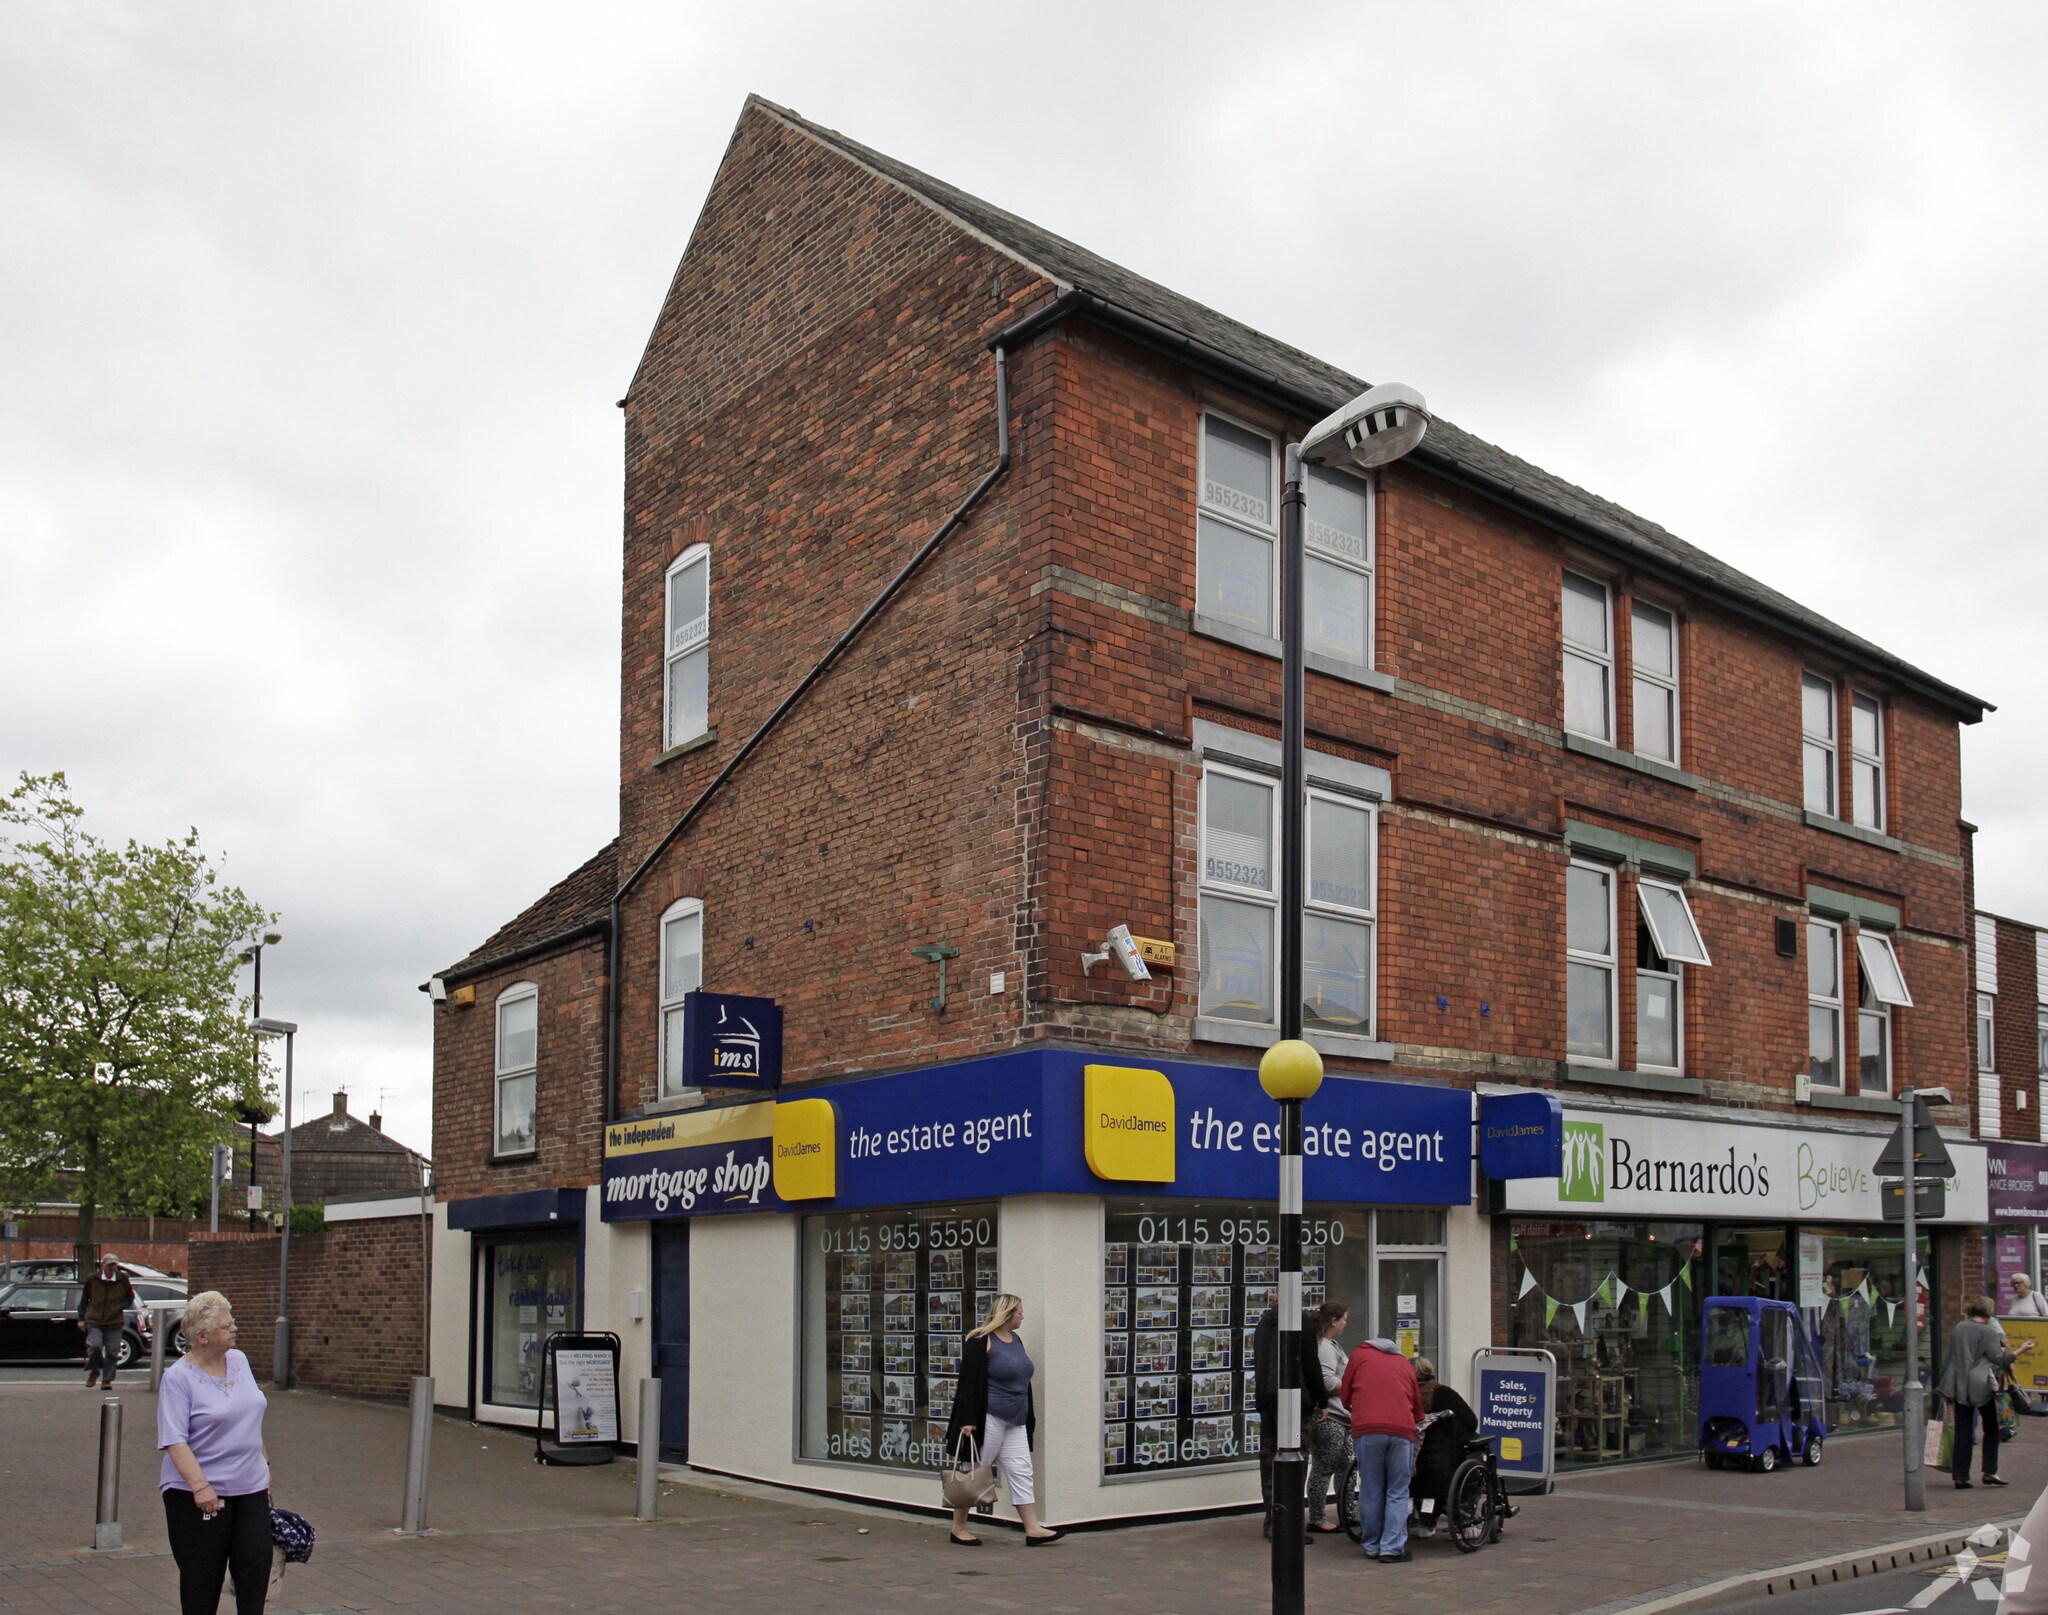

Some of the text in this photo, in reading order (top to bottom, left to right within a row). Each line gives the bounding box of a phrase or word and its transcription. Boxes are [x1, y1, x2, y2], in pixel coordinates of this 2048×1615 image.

[1206, 483, 1265, 520] 9552323
[1308, 523, 1360, 556] 9552323
[676, 620, 706, 648] 9552323
[1207, 858, 1266, 887] 9552323
[714, 1048, 752, 1069] ims
[609, 1121, 675, 1147] the independent
[850, 1108, 1032, 1159] the estate agent
[1100, 1113, 1167, 1132] DavidJames
[1487, 1124, 1545, 1139] DavidJames
[777, 1142, 821, 1158] DavidJames
[1190, 1107, 1444, 1172] the esate agent
[606, 1150, 770, 1212] mortgage shop
[1609, 1138, 1770, 1197] Barnardo's
[820, 1218, 990, 1253] 0115 955 5550
[1138, 1216, 1344, 1246] 0115 955 550
[1490, 1392, 1527, 1405] Lettings
[1500, 1380, 1527, 1392] Sales,
[1482, 1416, 1542, 1430] Management
[1492, 1405, 1533, 1418] Property
[820, 1428, 872, 1458] sales
[879, 1432, 894, 1460] &
[1139, 1426, 1210, 1466] sales
[1222, 1428, 1239, 1458] &
